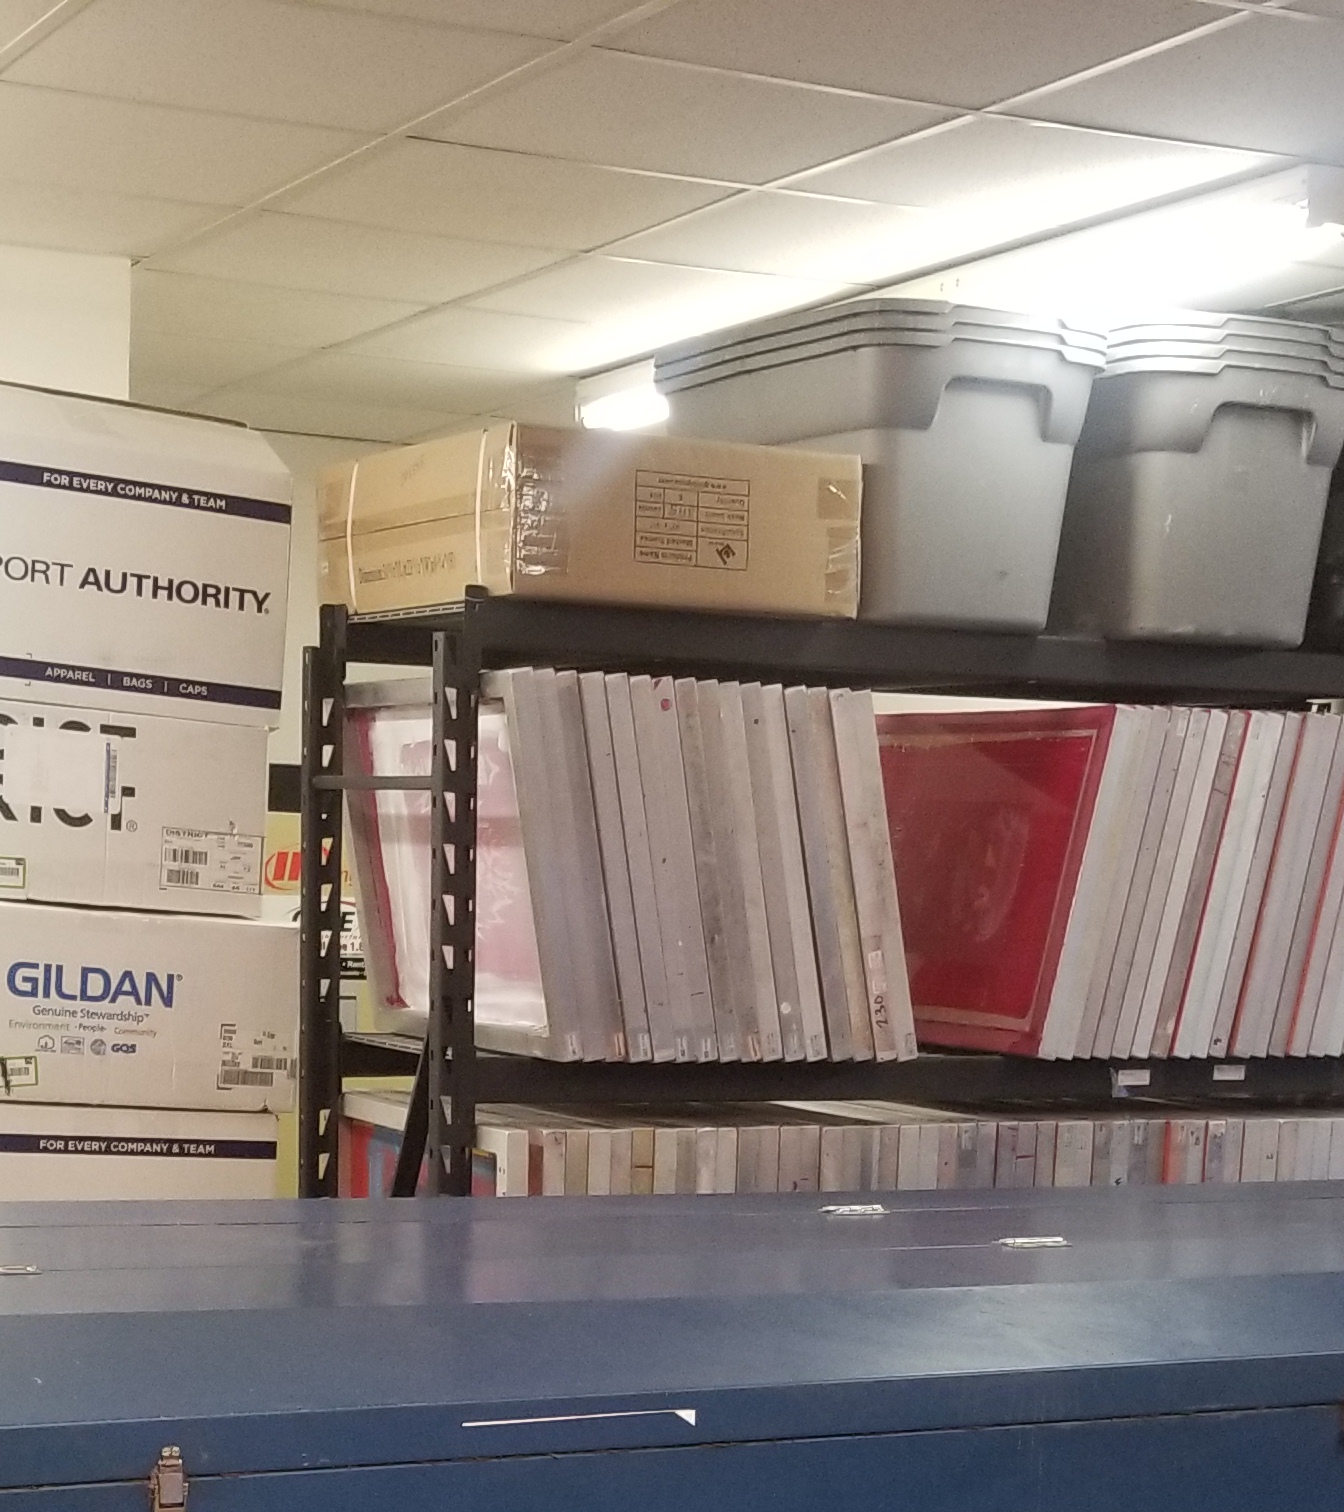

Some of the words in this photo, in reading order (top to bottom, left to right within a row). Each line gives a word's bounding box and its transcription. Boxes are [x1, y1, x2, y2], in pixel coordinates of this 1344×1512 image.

[42, 472, 70, 487] FOR
[72, 476, 114, 494] EVERY
[117, 482, 178, 503] COMPANY
[181, 492, 190, 504] &
[192, 494, 226, 510] TEAM
[44, 666, 96, 683] APPAREL
[122, 675, 153, 690] BAGS
[179, 681, 208, 697] CAPS
[32, 1005, 78, 1018] Genuine
[9, 1020, 69, 1031] Environment
[114, 1026, 157, 1038] Community
[39, 1139, 65, 1151] FOR
[68, 1140, 108, 1152] EVERY
[110, 1142, 169, 1154] COMPANY
[171, 1143, 180, 1154] &
[182, 1144, 215, 1155] TEAM
